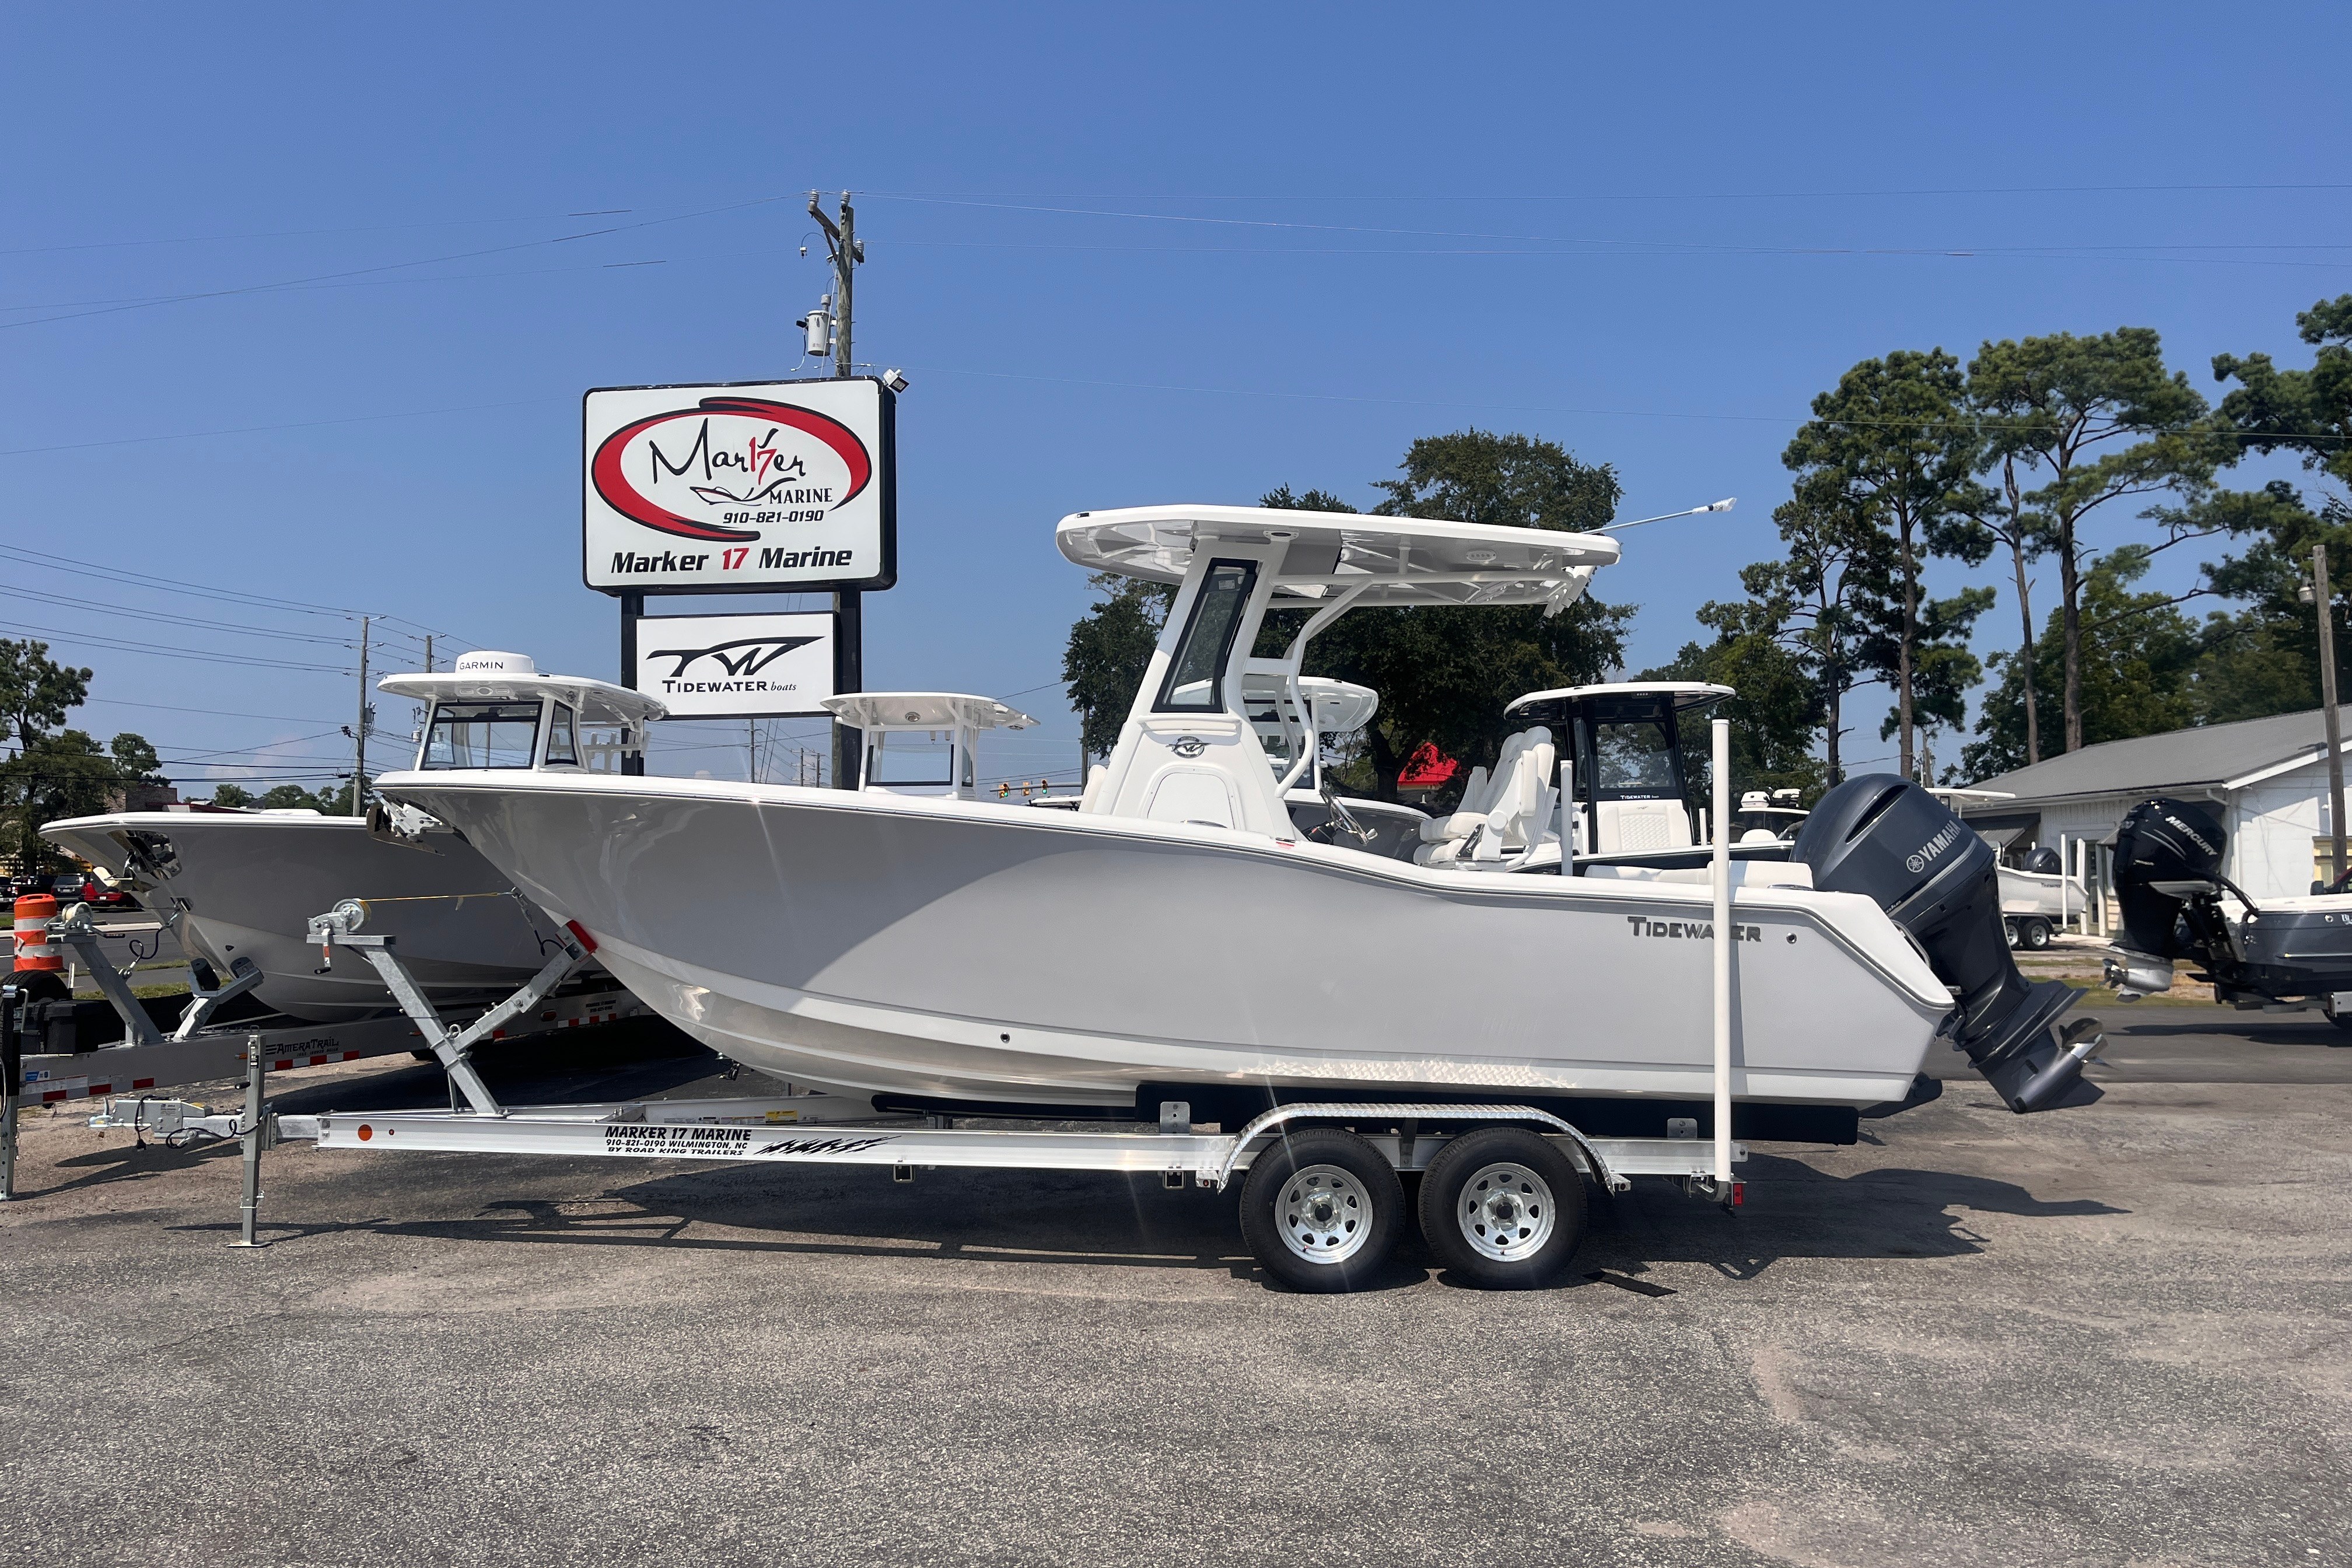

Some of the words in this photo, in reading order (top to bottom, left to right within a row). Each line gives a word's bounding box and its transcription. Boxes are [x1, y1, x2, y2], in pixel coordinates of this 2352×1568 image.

[769, 487, 833, 505] MARINE
[723, 509, 824, 524] 910-821-0190
[611, 550, 709, 573] Marker
[722, 547, 750, 571] 17
[758, 545, 853, 569] Marine
[459, 662, 503, 670] GARMIN
[662, 680, 769, 693] TIDEWATER
[770, 681, 797, 691] boats
[1917, 820, 1961, 861] YAMAHA
[2165, 816, 2217, 856] MERCURY
[1627, 916, 1761, 943] TIDEWAER
[605, 1126, 667, 1139] MARKER
[671, 1128, 687, 1139] 17
[691, 1128, 752, 1140] MARINE
[606, 1139, 665, 1147] 910-821-0190
[669, 1140, 732, 1149] WILMINGTON,
